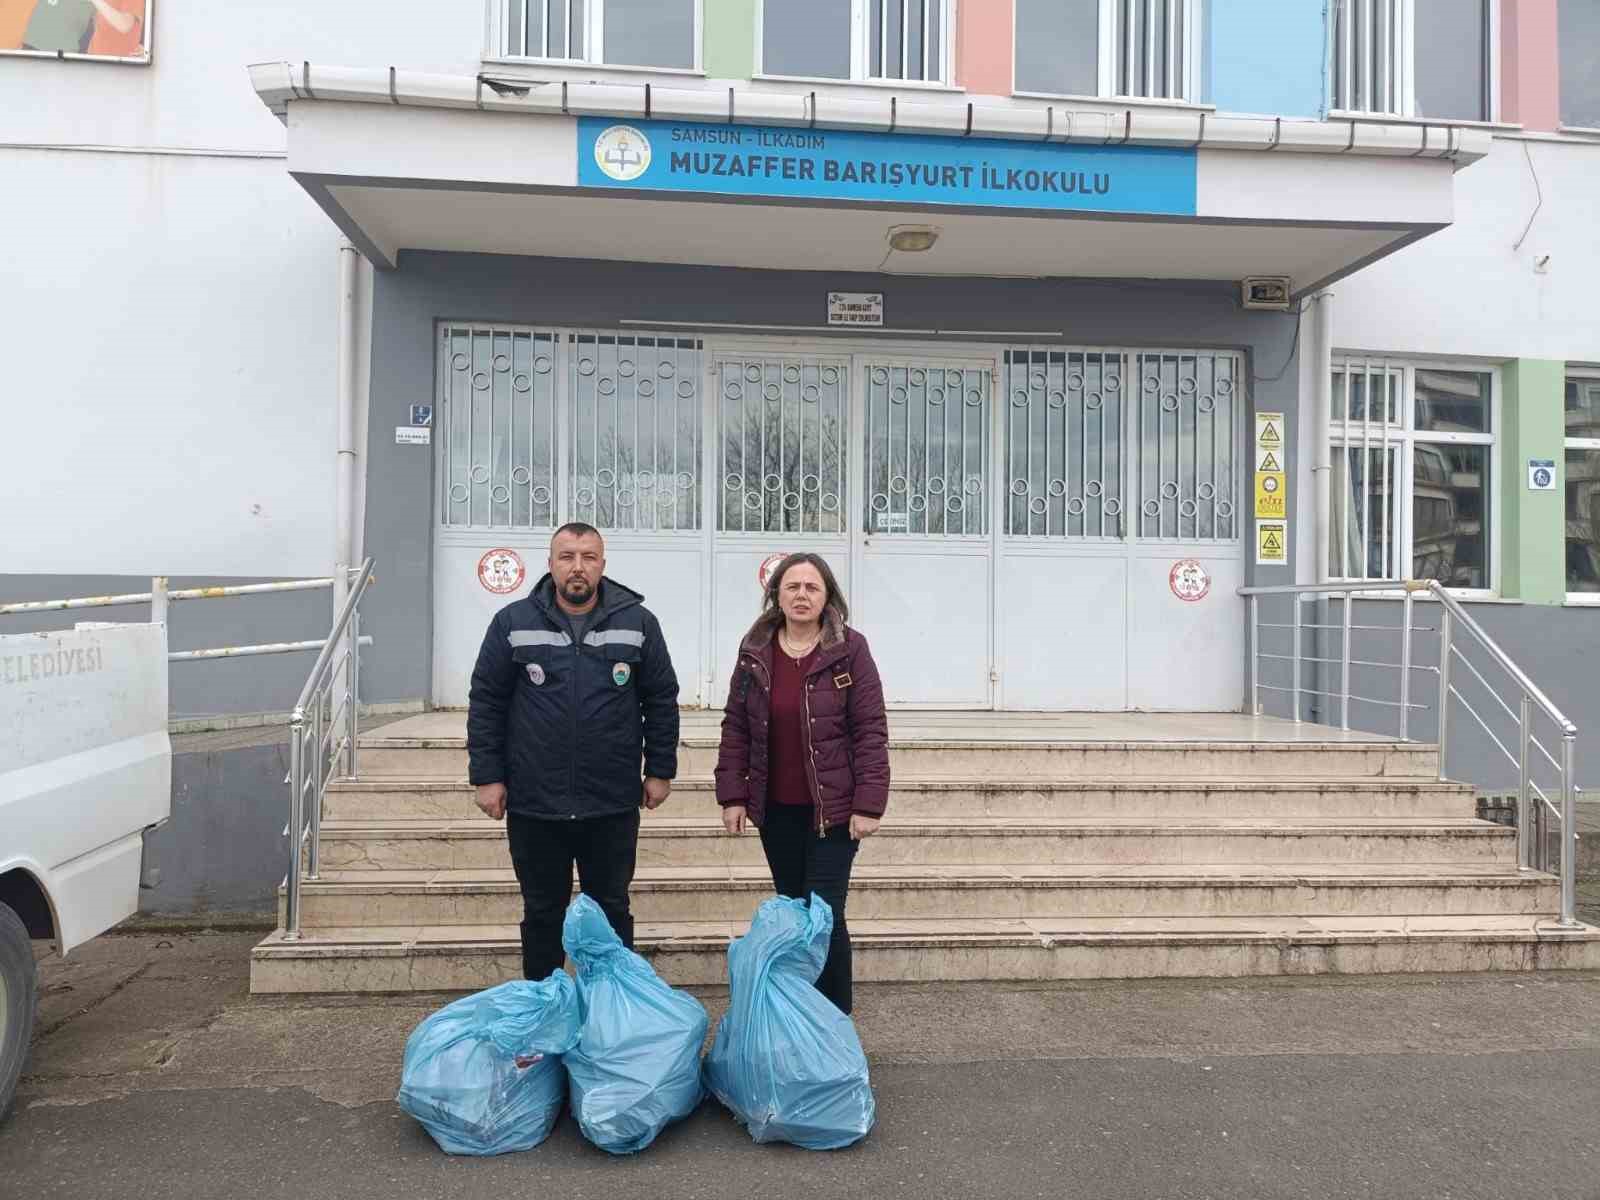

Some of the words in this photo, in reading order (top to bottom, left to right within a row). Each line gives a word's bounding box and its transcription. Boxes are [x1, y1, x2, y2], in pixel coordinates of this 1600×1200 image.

[671, 127, 741, 145] SAMSUN
[757, 128, 825, 150] İLKADIM
[670, 151, 815, 180] MUZAFFER
[823, 159, 974, 188] BARIŞYURT
[981, 161, 1110, 194] İLKOKULU
[0, 639, 104, 684] ELEDİYESİ
